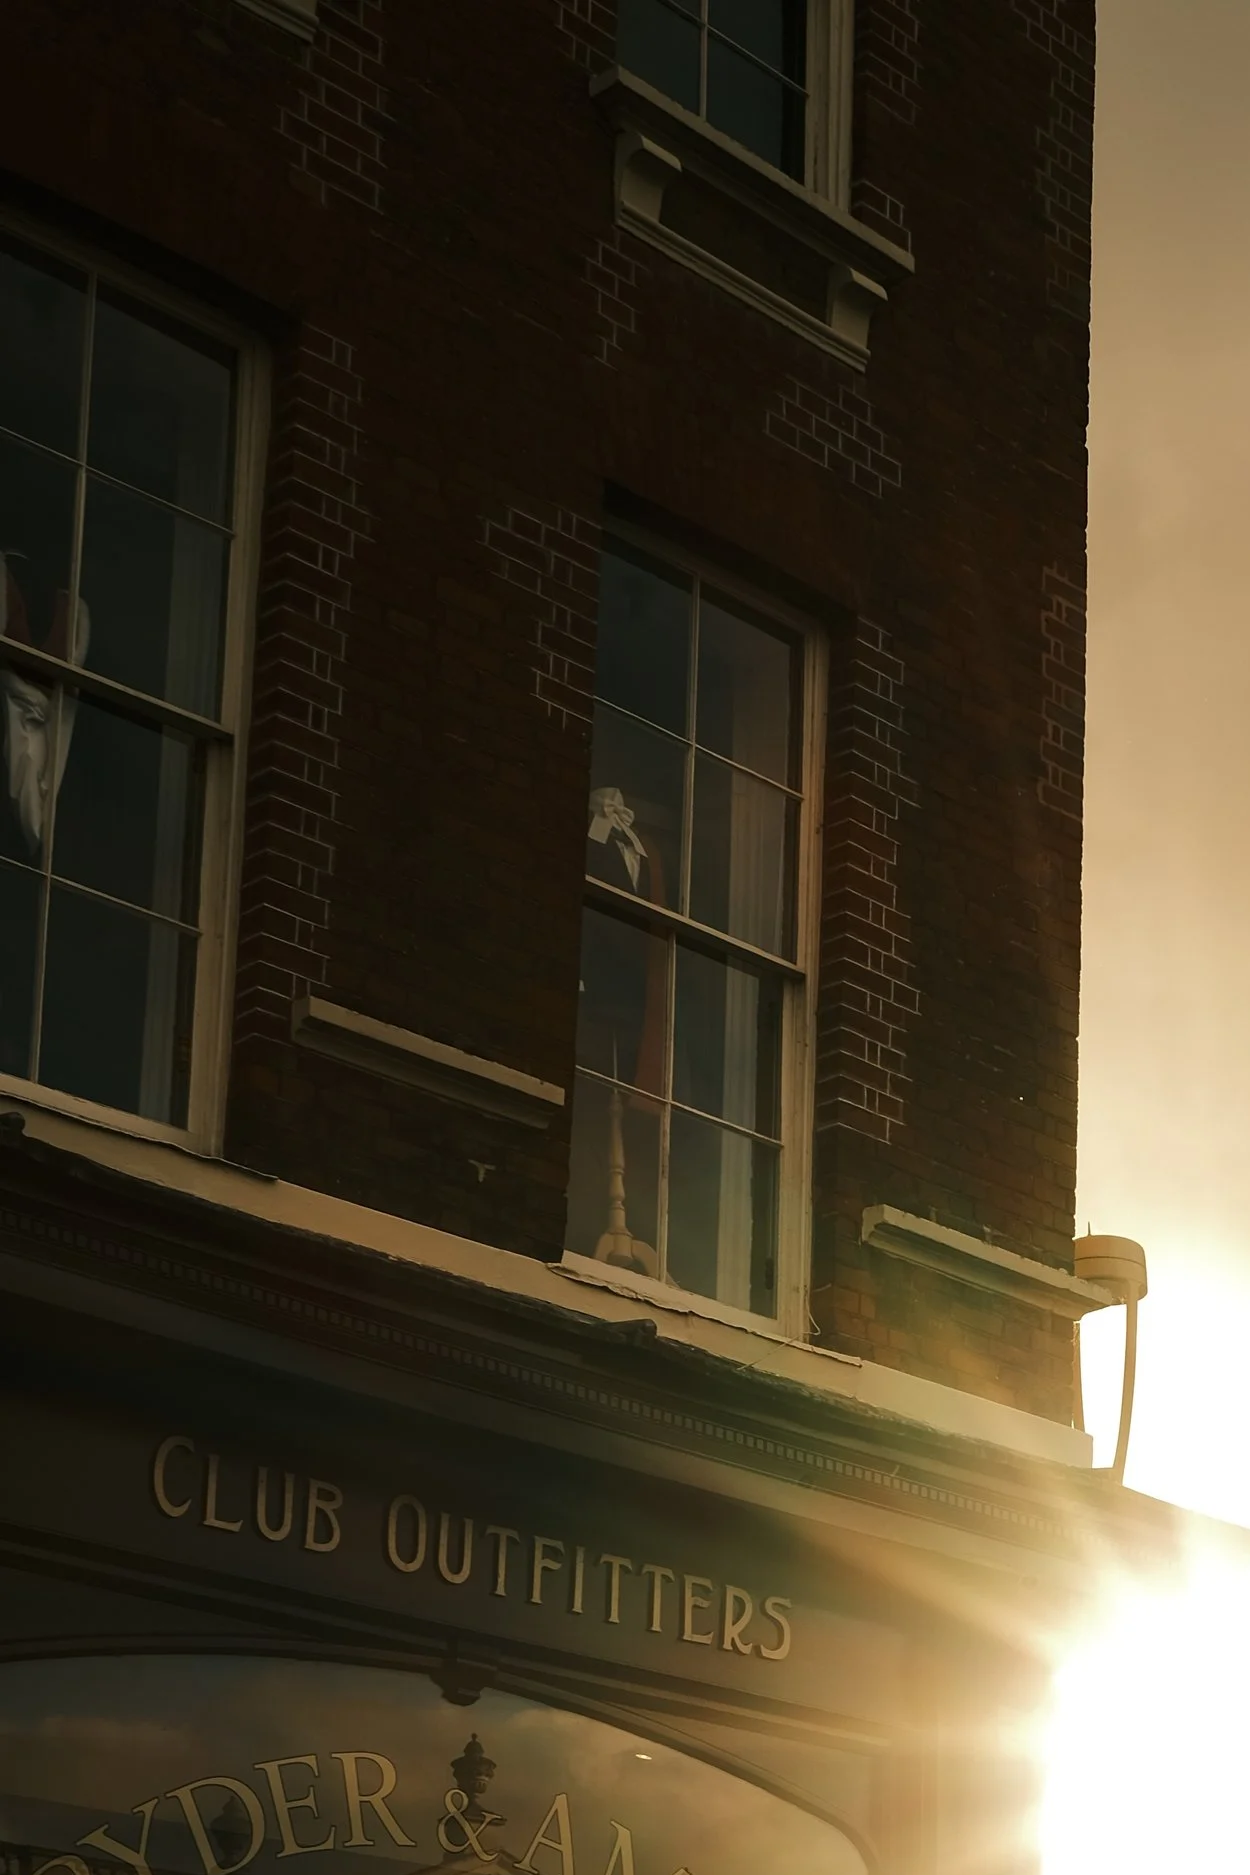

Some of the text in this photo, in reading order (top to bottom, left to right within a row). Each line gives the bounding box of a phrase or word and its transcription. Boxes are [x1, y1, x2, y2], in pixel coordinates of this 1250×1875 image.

[153, 1436, 793, 1661] CLUB OUTFITTERS
[436, 1789, 505, 1861] &
